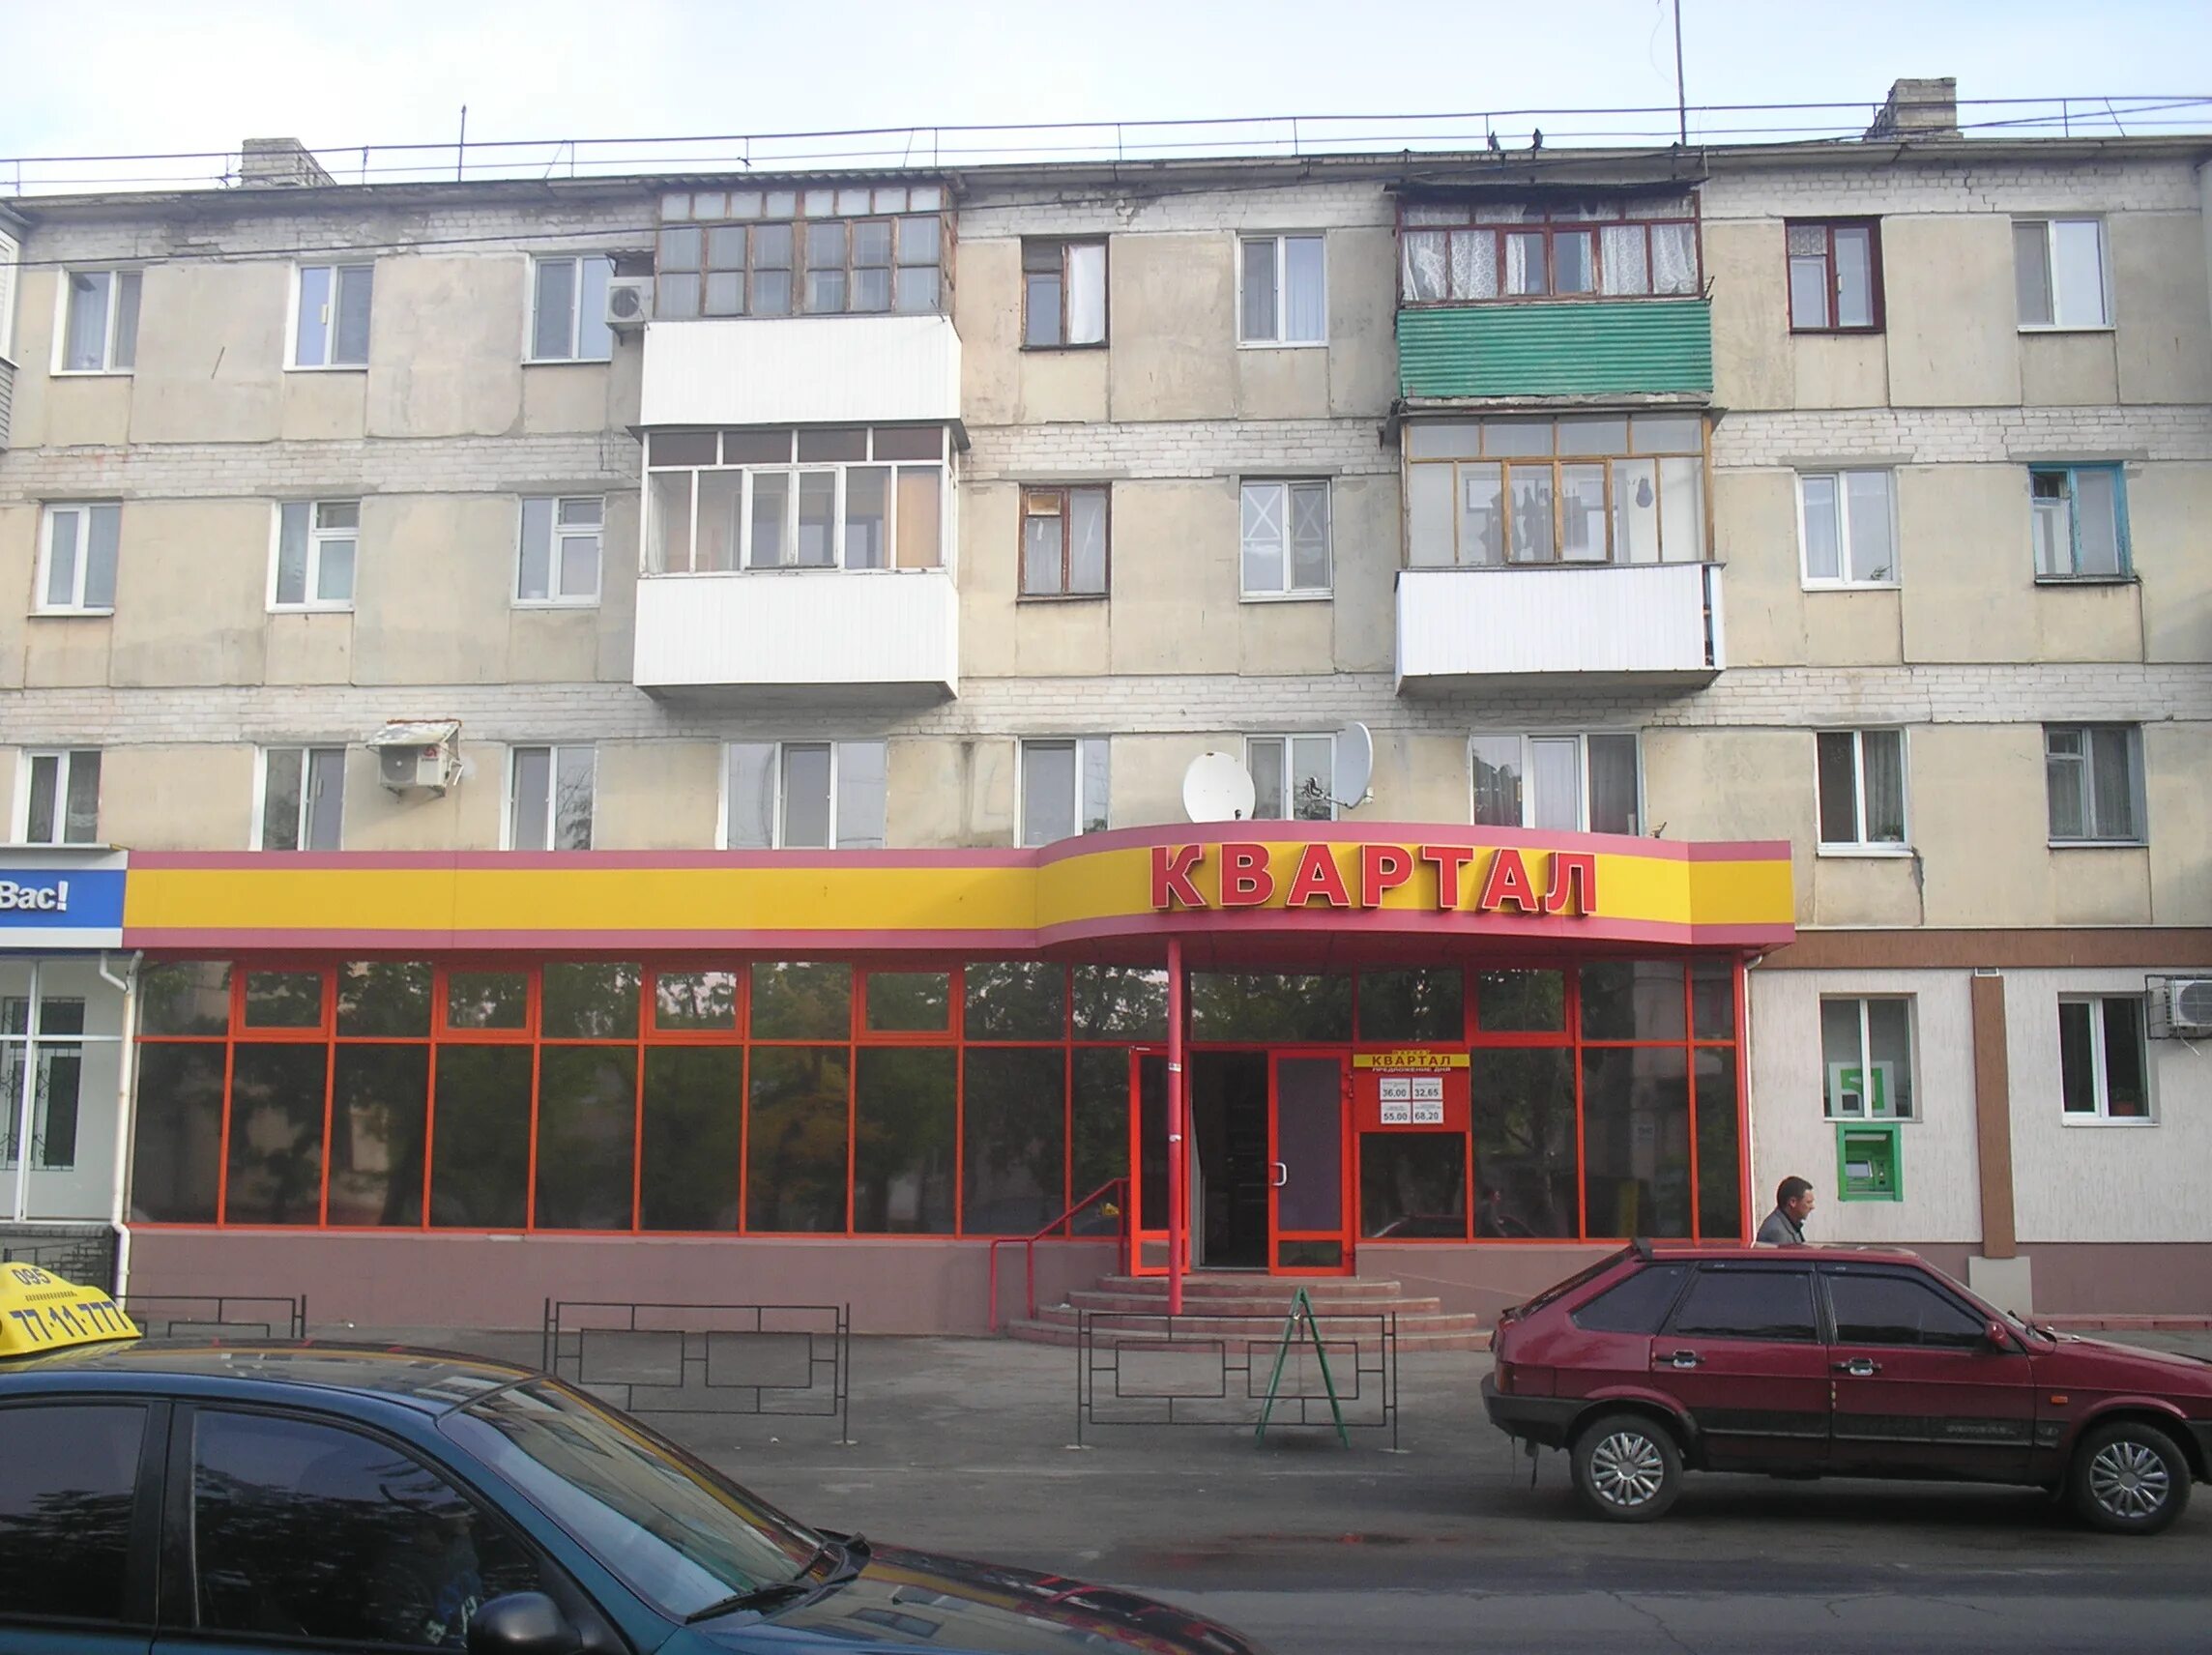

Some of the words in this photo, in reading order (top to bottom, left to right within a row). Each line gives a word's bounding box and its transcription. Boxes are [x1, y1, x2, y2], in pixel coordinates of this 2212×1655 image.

[1150, 843, 1597, 915] КВАРТАЛ
[0, 880, 69, 912] Вас!
[1372, 1056, 1451, 1065] КВАРТАЛ
[12, 1267, 51, 1286] 095
